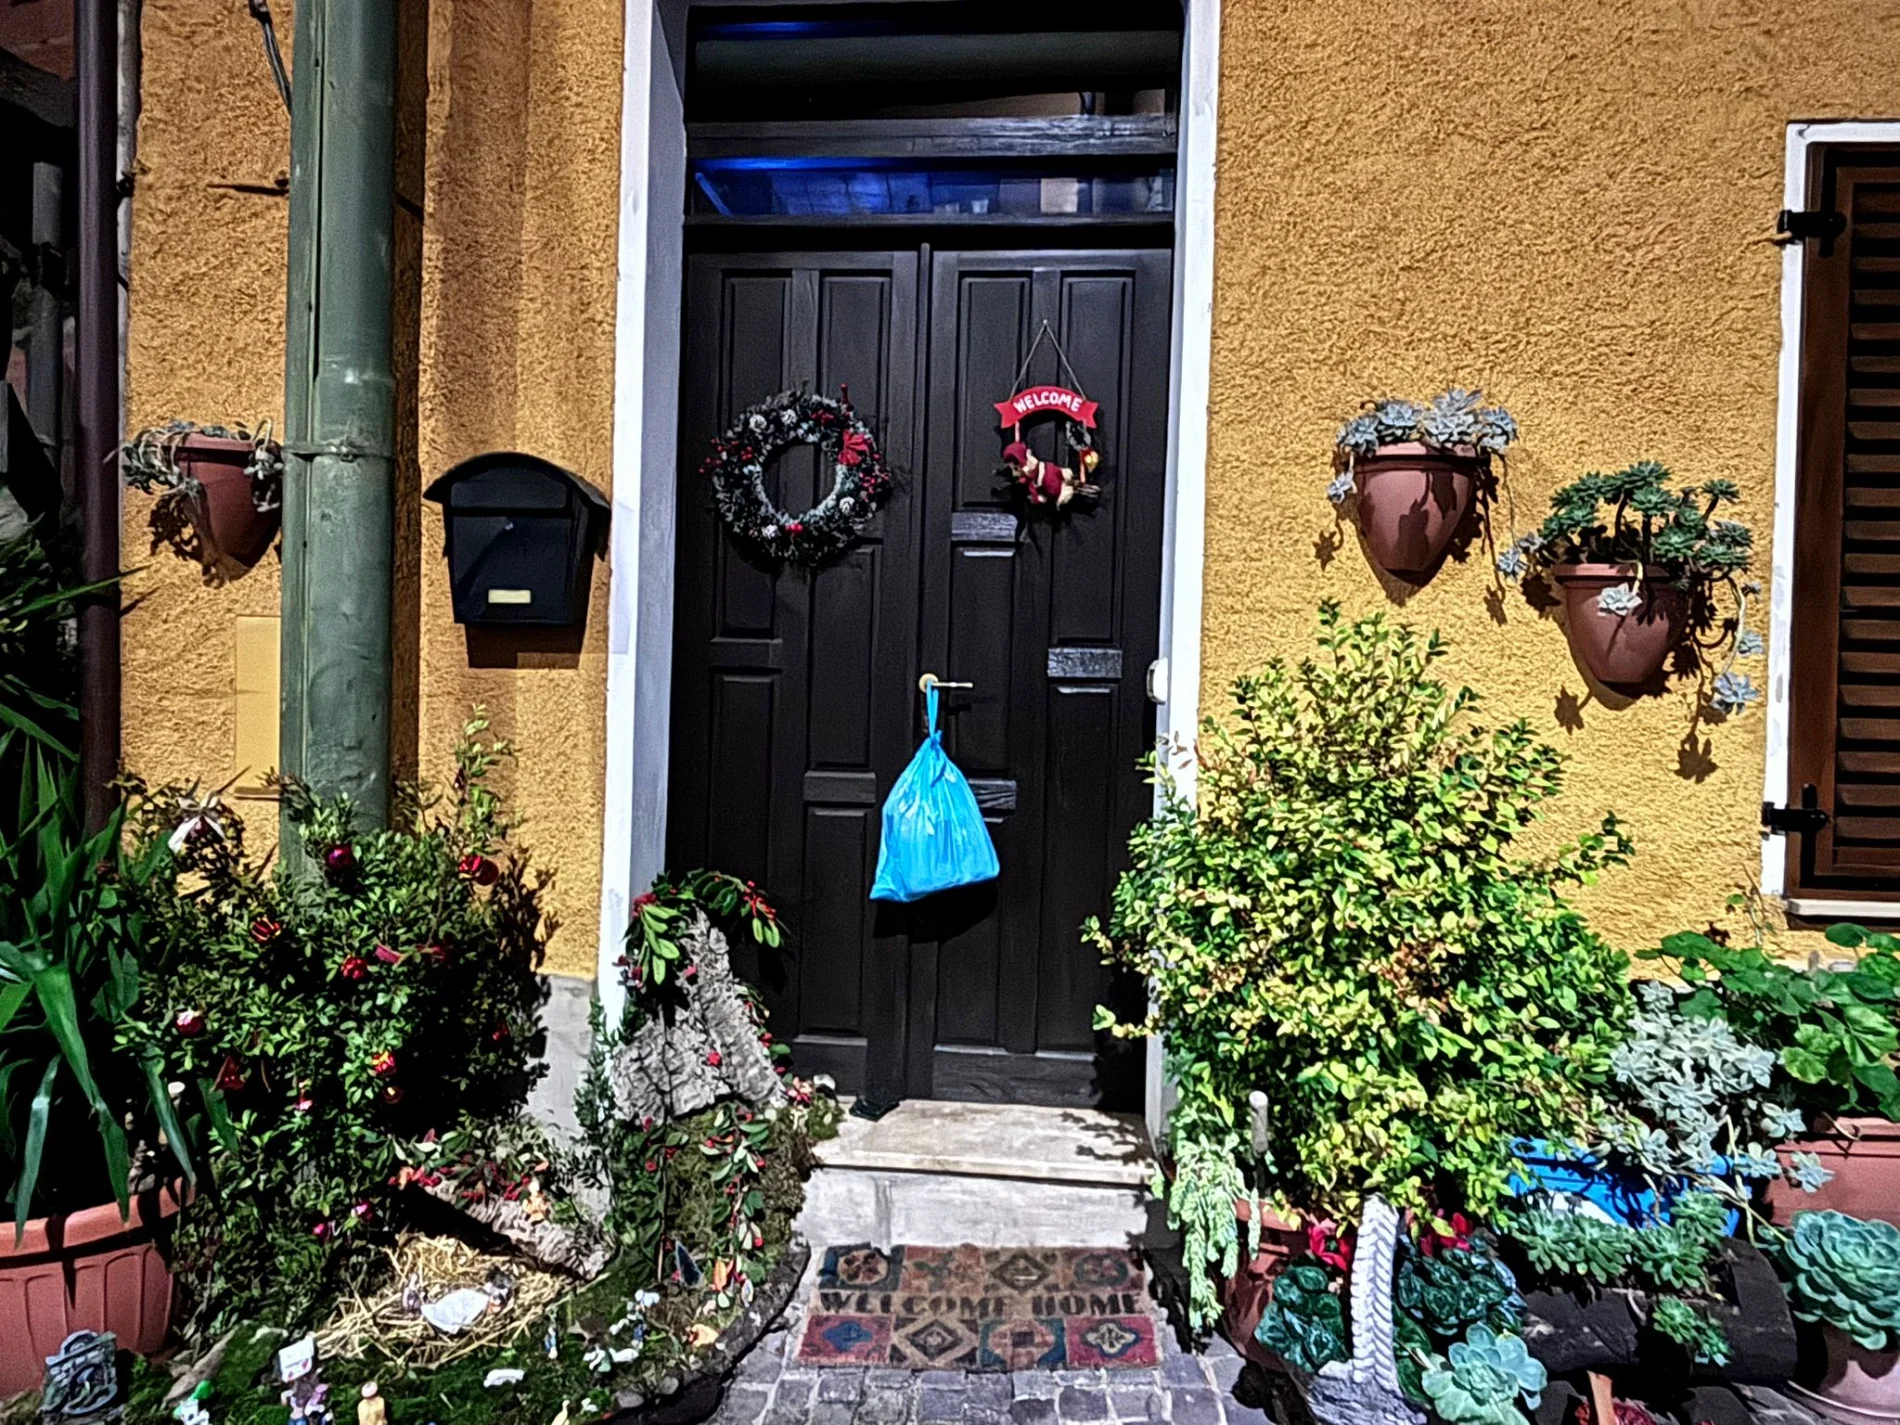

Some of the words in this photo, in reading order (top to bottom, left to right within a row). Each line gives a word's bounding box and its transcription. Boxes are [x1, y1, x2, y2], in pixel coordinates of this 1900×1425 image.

[1013, 391, 1083, 412] WELCOME
[821, 1291, 1014, 1316] WELCOME
[1033, 1291, 1141, 1316] HOME
